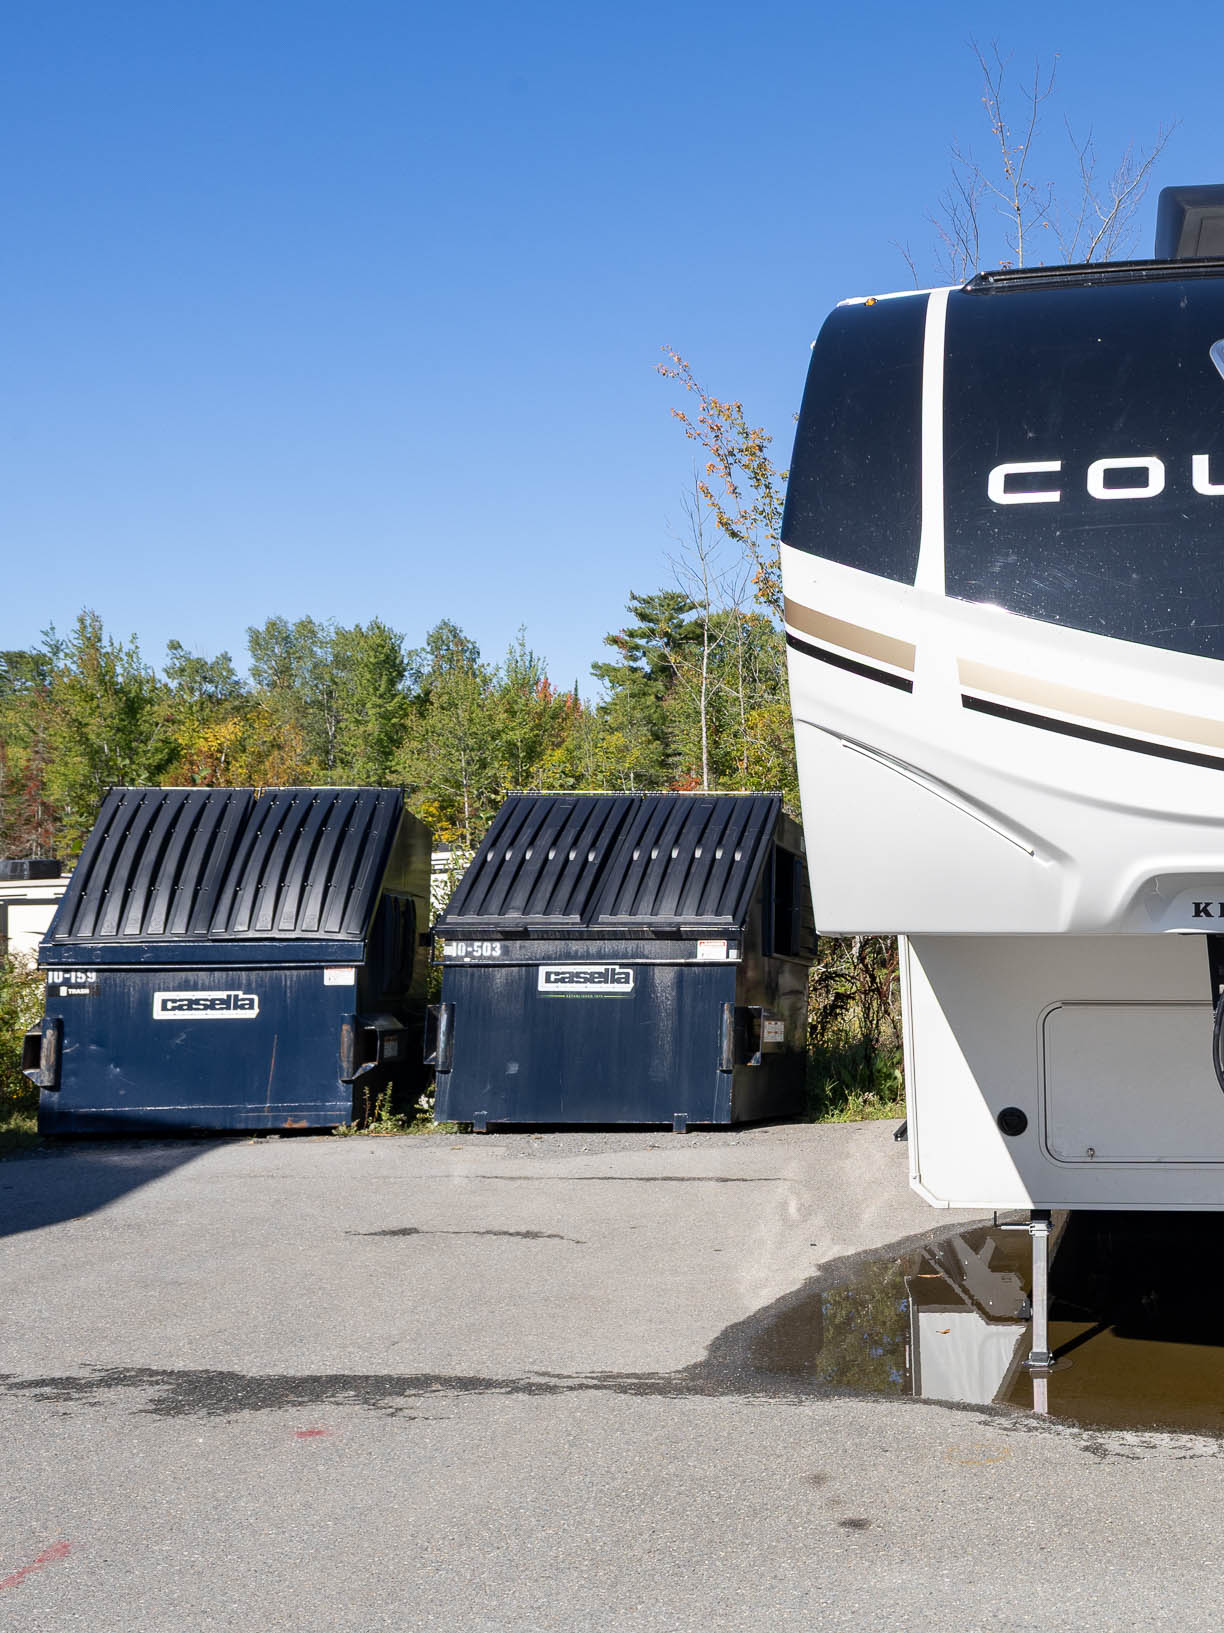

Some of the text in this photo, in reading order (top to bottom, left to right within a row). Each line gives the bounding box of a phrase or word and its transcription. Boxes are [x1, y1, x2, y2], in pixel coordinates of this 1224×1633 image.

[452, 942, 501, 957] 10-503
[544, 967, 631, 985] casella
[160, 994, 256, 1012] casella
